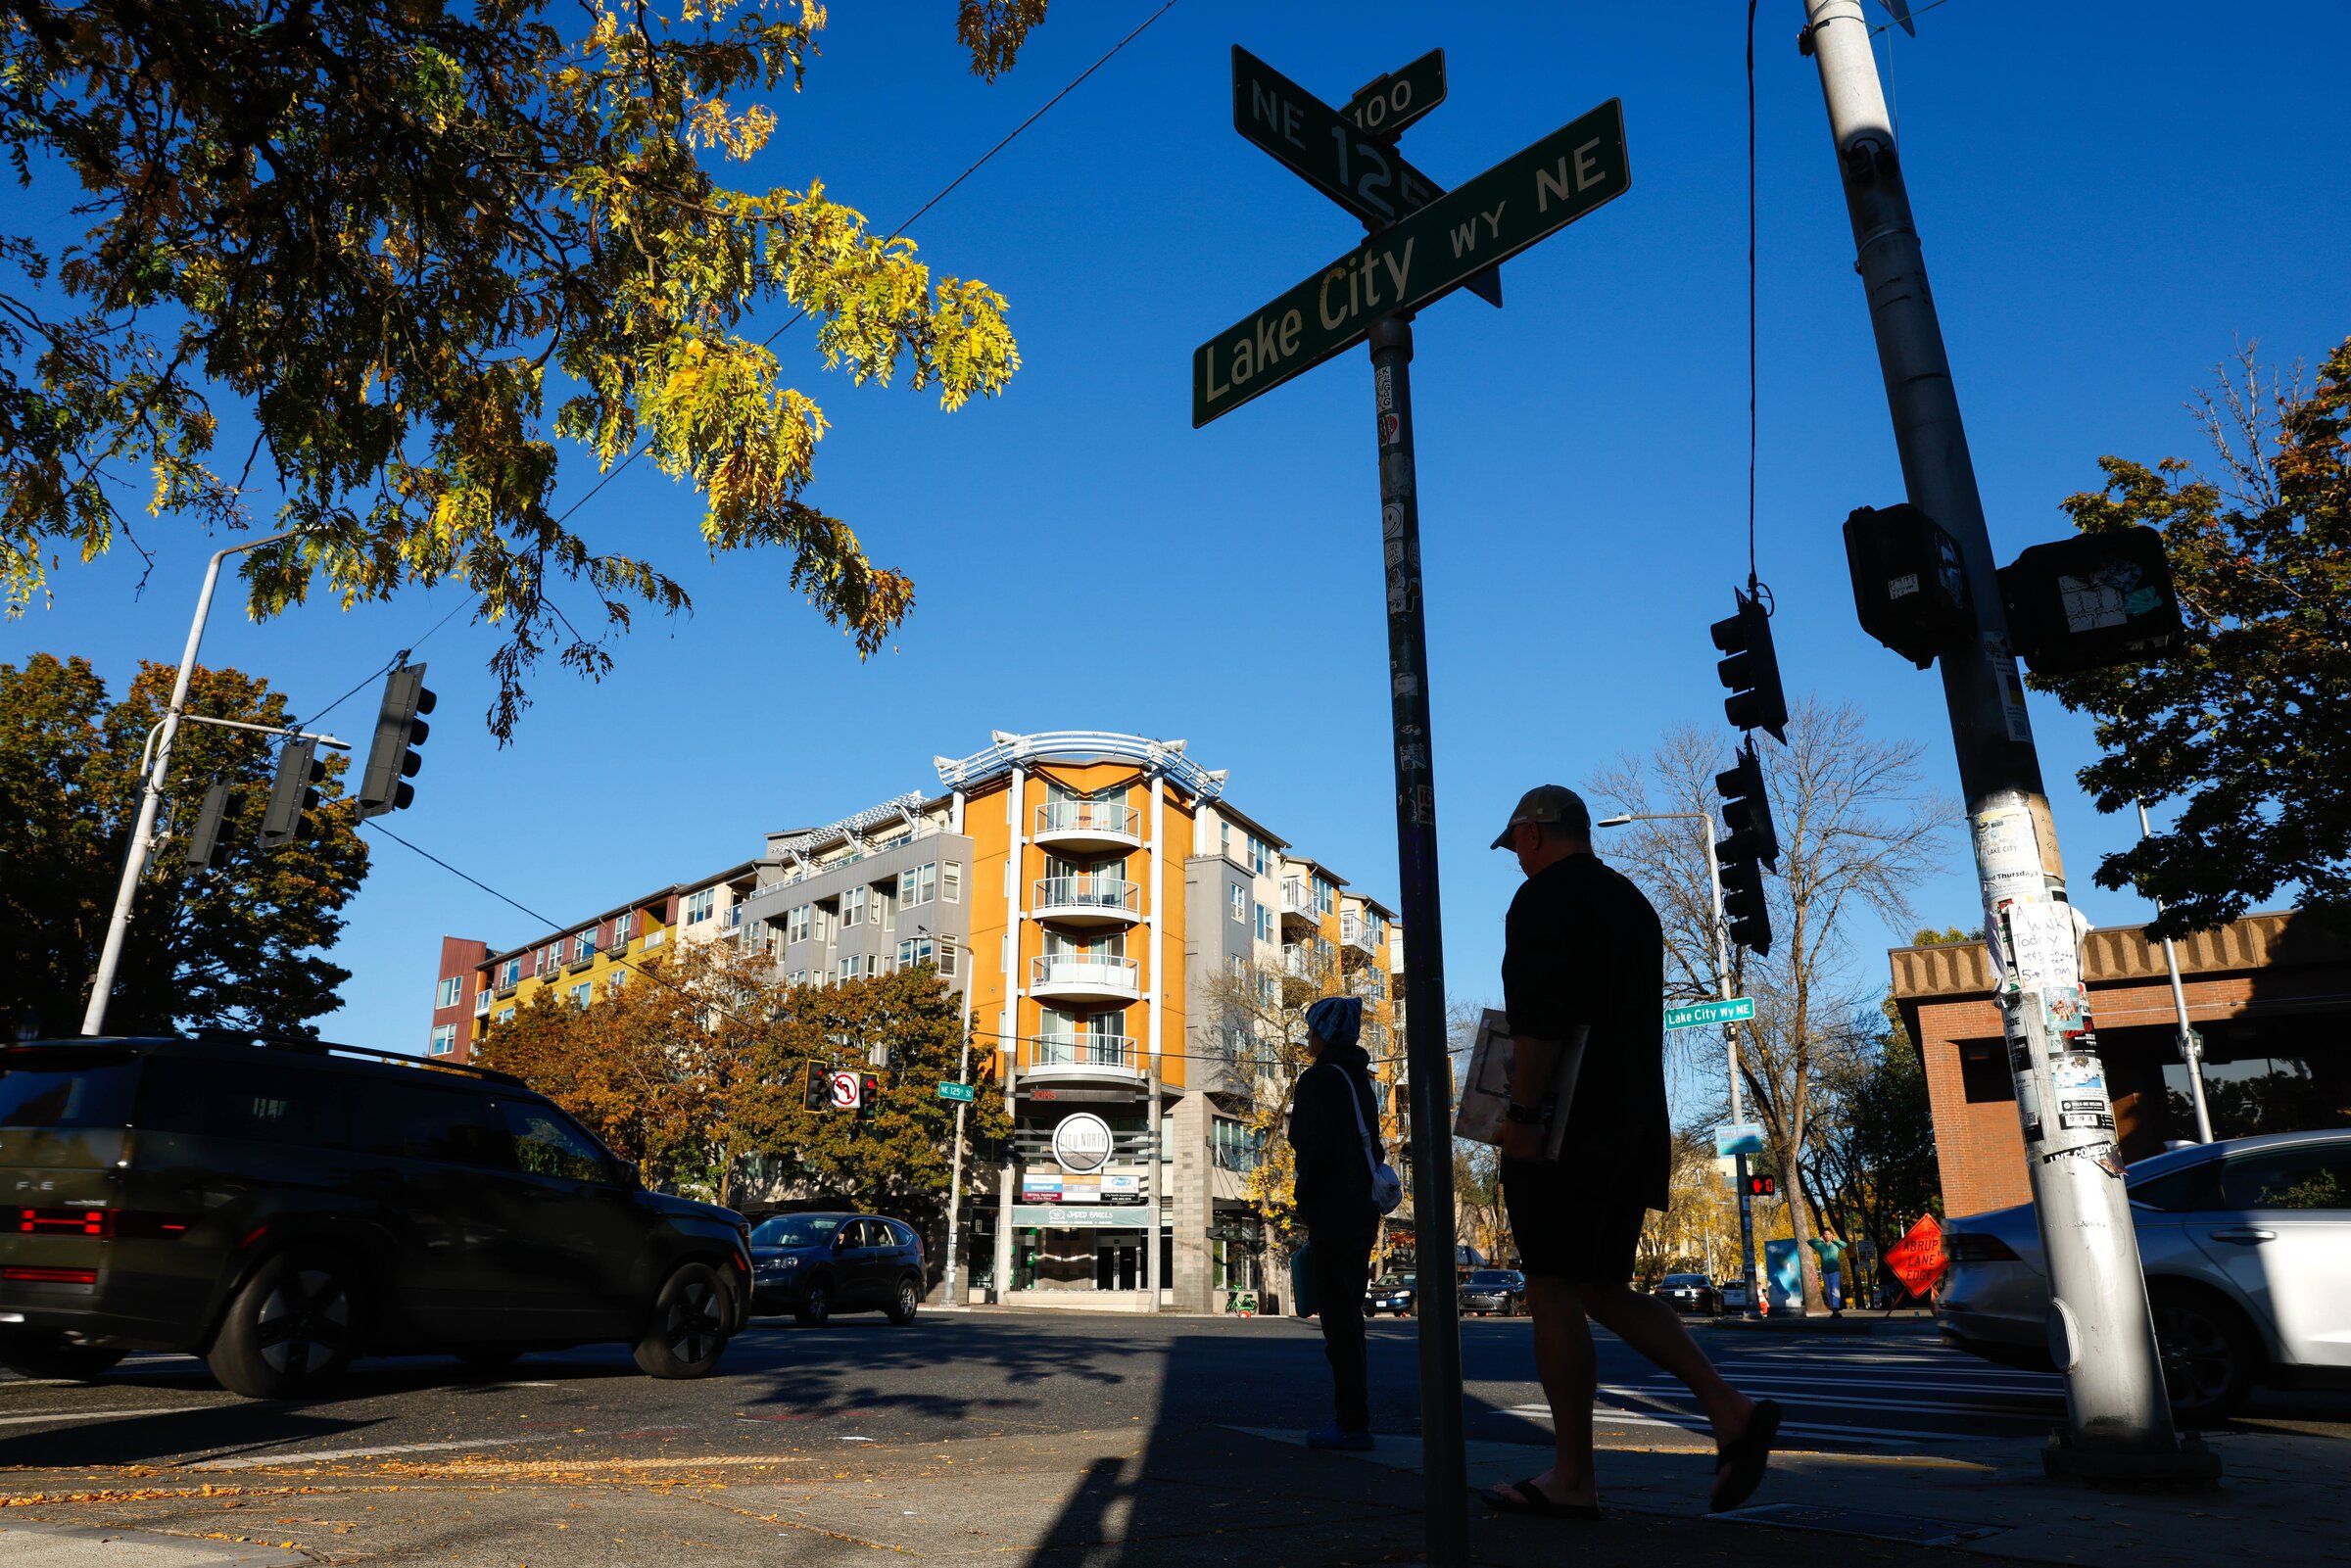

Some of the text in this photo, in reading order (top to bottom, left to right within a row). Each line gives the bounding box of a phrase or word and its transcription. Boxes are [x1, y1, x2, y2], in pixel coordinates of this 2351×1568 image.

[1355, 79, 1413, 129] 100
[1252, 77, 1307, 152] NE
[1206, 309, 1303, 403] Lake
[1318, 236, 1415, 332] City
[1450, 201, 1507, 259] WY
[1535, 136, 1607, 213] NE
[1987, 846, 2001, 855] LAKE
[1996, 871, 2039, 879] Thursdays
[1668, 1004, 1750, 1024] Lake City Wy NE
[1080, 1133, 1106, 1148] NORTH
[2074, 1143, 2111, 1159] COMEDY
[1903, 1240, 1939, 1252] ABRUP
[1907, 1255, 1936, 1266] LANE
[1905, 1269, 1933, 1282] EDGE
